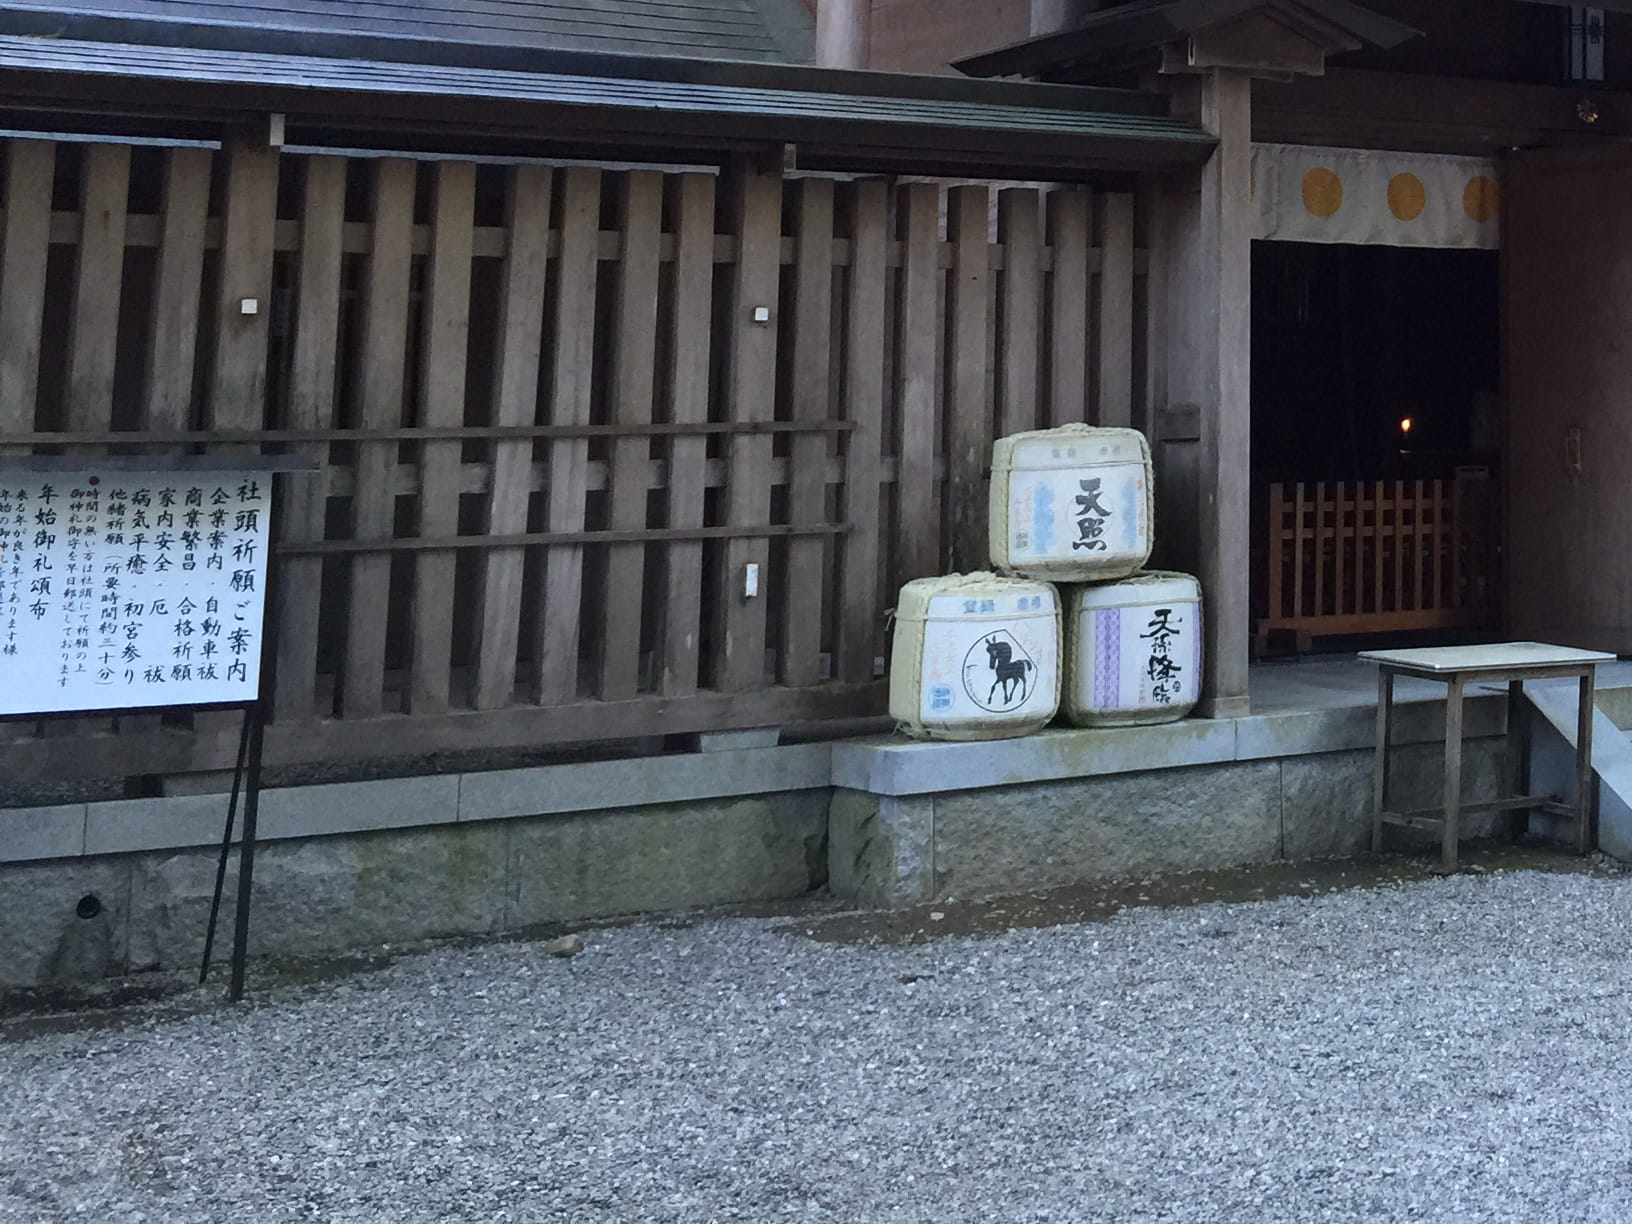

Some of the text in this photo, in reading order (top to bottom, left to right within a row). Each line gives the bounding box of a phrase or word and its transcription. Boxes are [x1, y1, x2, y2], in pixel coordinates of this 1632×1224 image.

[227, 479, 262, 682] 社頭祈願ご案内
[1072, 477, 1112, 551] 天照
